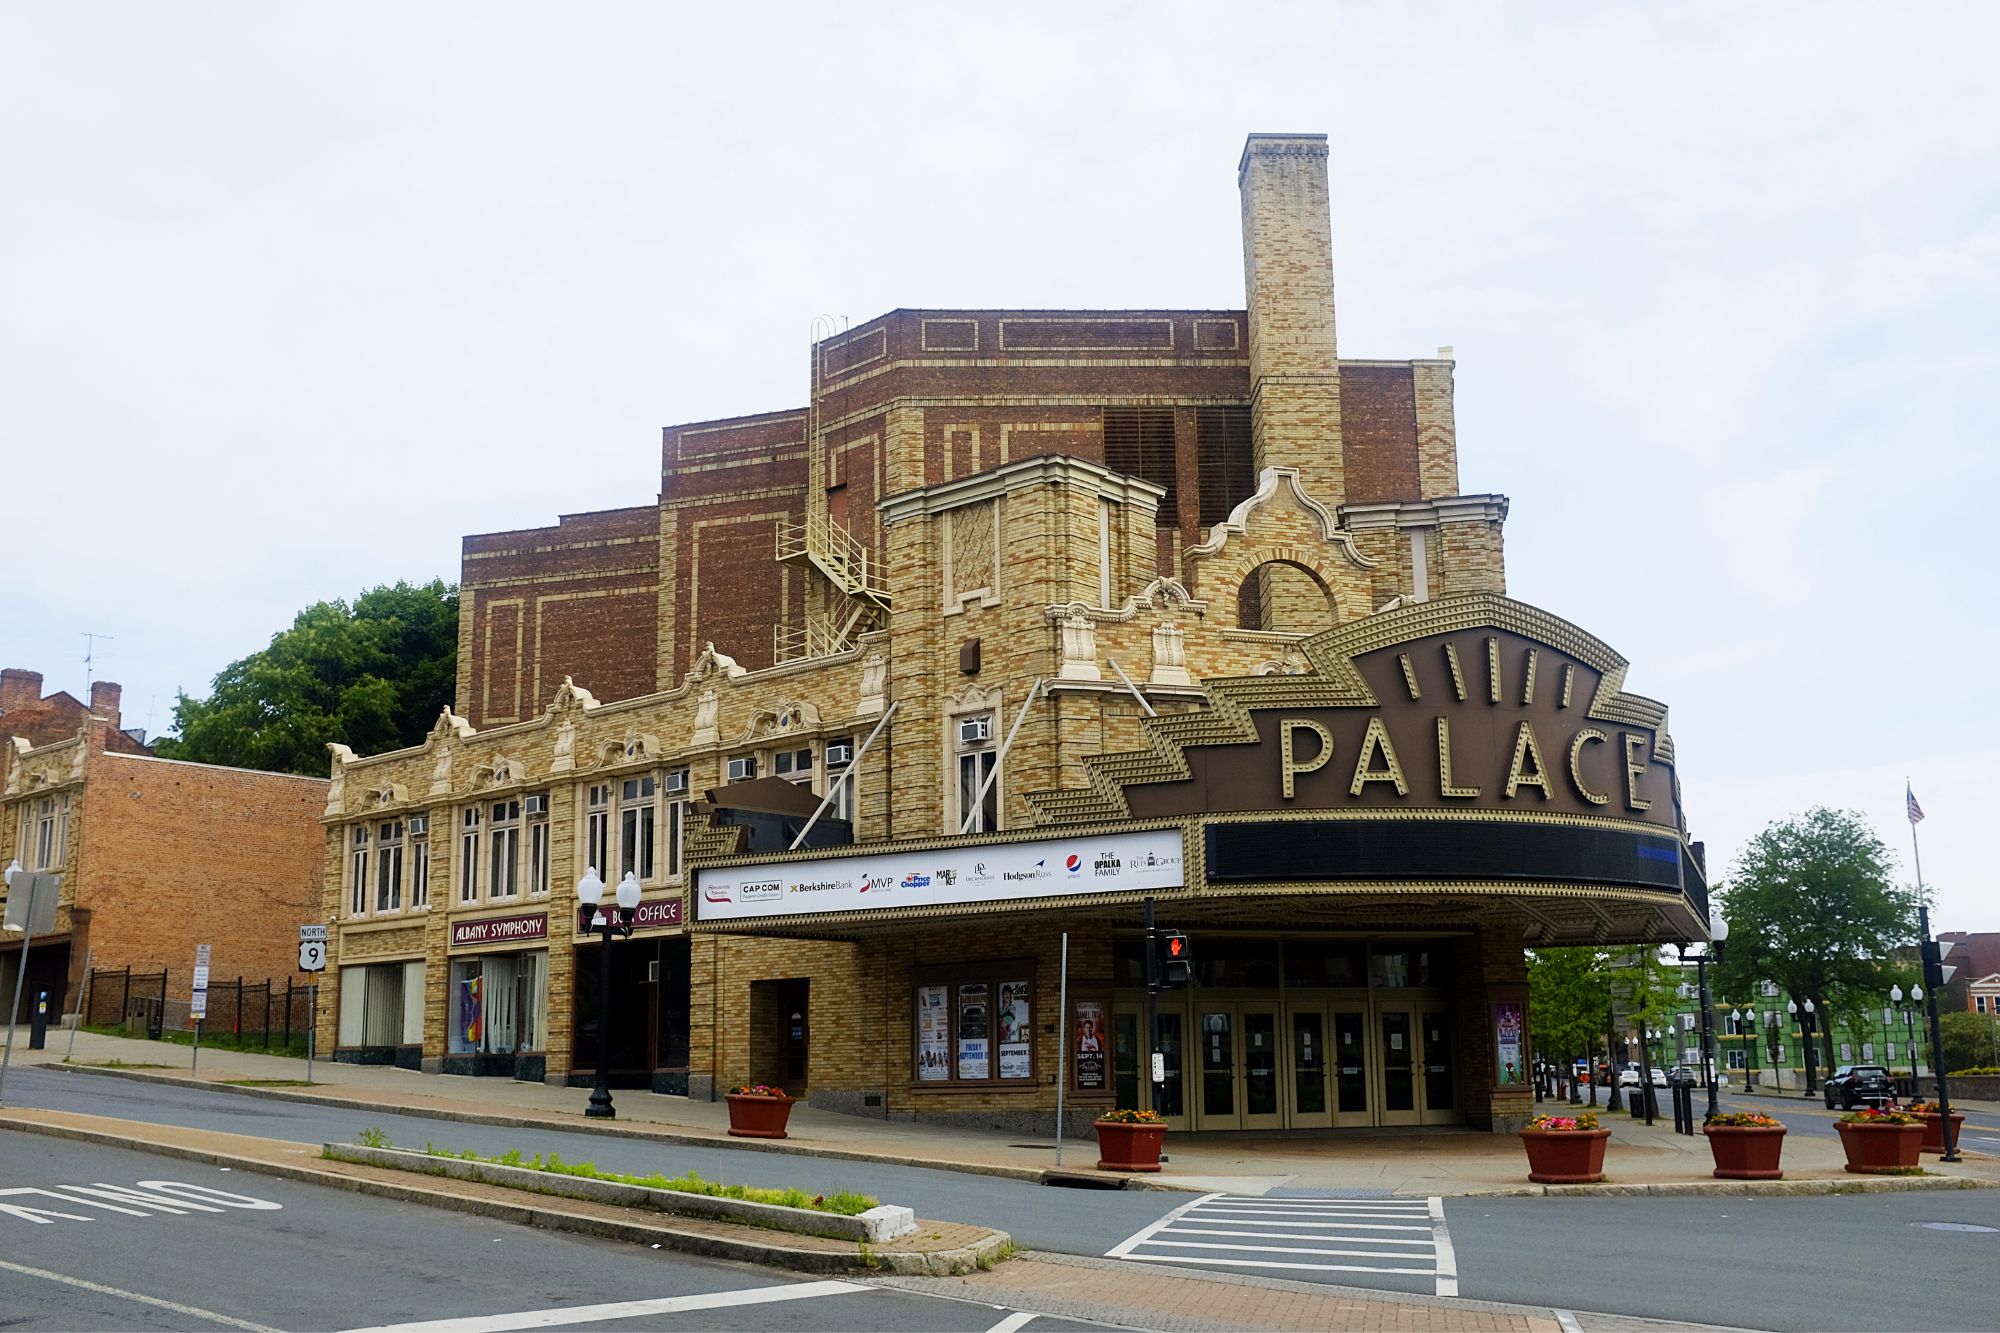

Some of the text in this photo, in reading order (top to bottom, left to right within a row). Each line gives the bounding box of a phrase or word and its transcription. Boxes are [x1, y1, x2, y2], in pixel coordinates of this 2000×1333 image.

[1279, 715, 1652, 811] PALACE
[1100, 852, 1115, 860] THE
[1094, 859, 1121, 870] OPALKA
[1094, 868, 1121, 877] FAMILY
[871, 877, 894, 889] MVP
[913, 875, 931, 883] Price
[743, 884, 780, 893] CAP COM
[900, 880, 931, 889] Chopper
[638, 903, 677, 921] OFFICE
[301, 927, 326, 937] NORTH
[456, 919, 543, 941] ALBANY SYMPHONY
[308, 947, 319, 964] 9
[965, 1043, 982, 1051] FRIDAY
[960, 1051, 984, 1060] SEPTEMBER
[1000, 1049, 1027, 1057] SEPTEMBER
